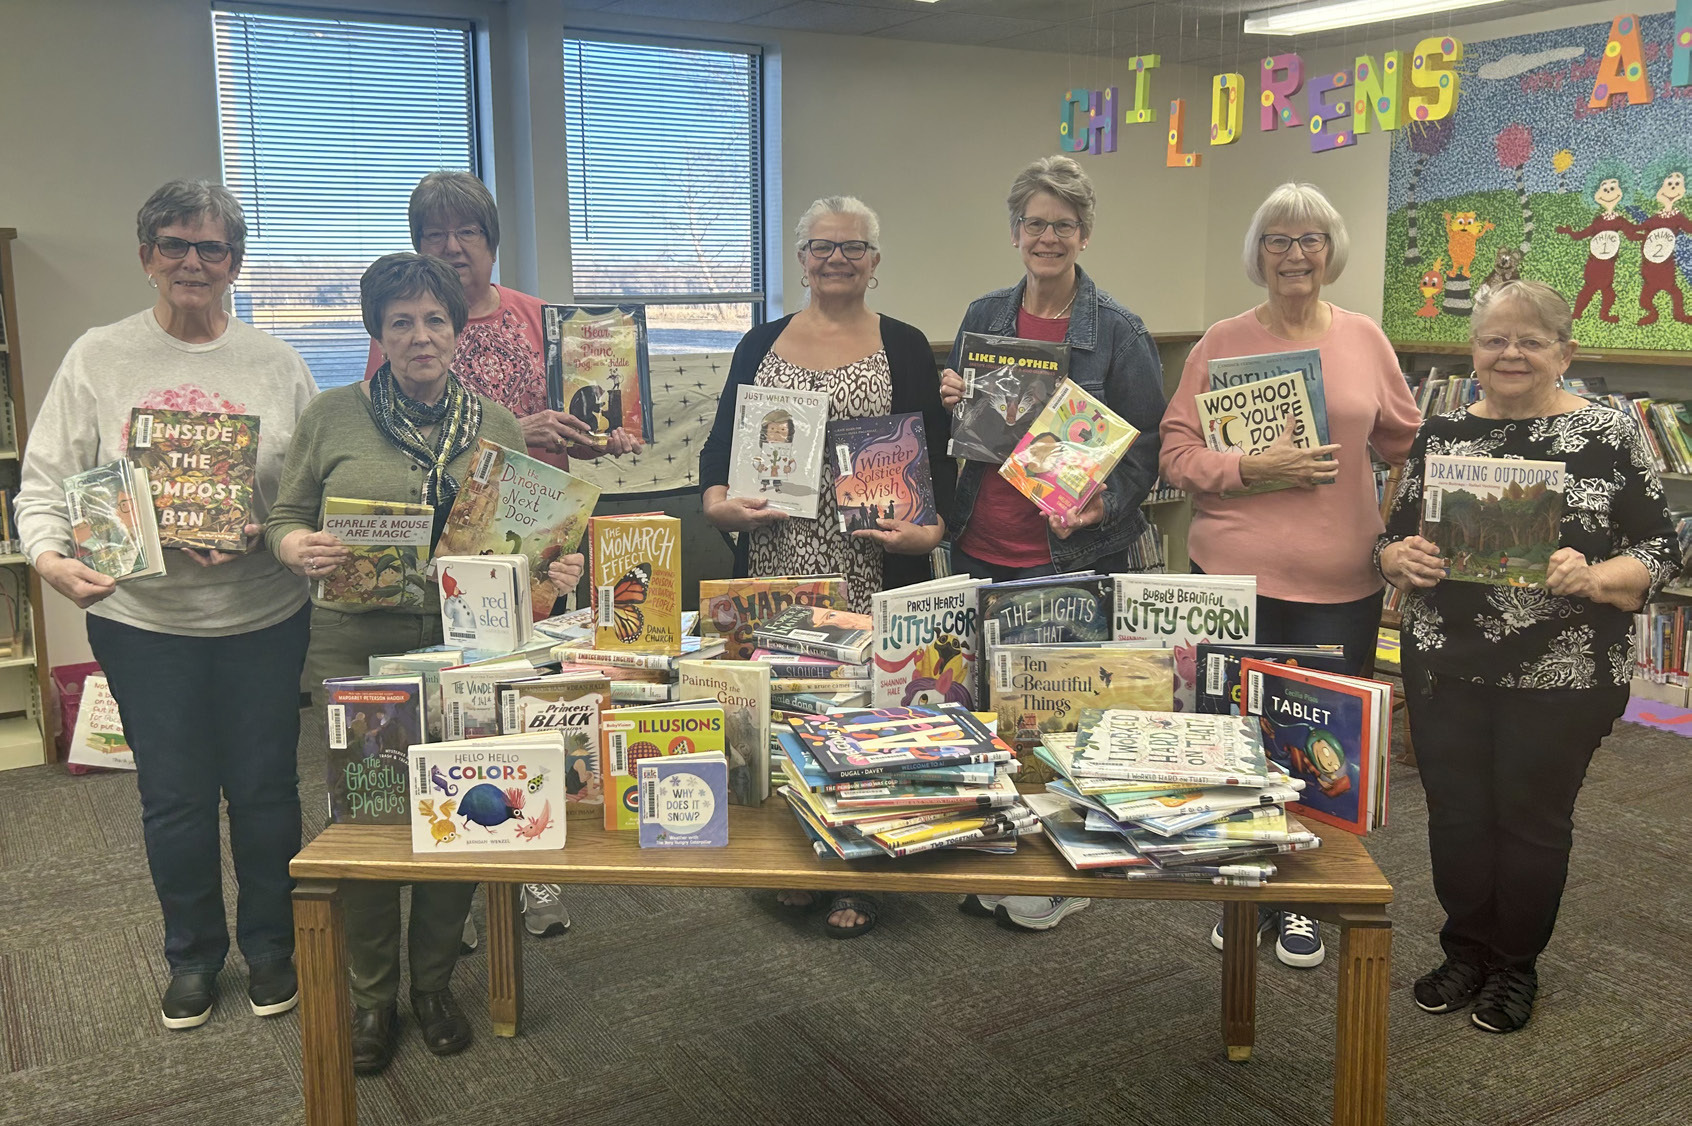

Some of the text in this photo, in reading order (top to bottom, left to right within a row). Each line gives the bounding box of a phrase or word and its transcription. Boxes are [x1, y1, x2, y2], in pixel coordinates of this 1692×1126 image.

[1059, 36, 1463, 167] CHILDRENS
[1594, 233, 1617, 244] THING
[1647, 230, 1674, 243] THING
[1600, 243, 1610, 254] 1
[1652, 244, 1664, 258] 2
[968, 352, 1058, 370] LIKE NO OTHER
[744, 391, 819, 406] JUST WHAT TO DO
[1204, 379, 1297, 416] WOO HOO!
[1240, 400, 1303, 427] YOU'RE
[152, 423, 233, 442] INSIDE
[1250, 419, 1305, 446] DOIG
[168, 453, 211, 470] THE
[861, 445, 913, 471] Winter
[500, 463, 566, 502] Dinosaur
[527, 468, 539, 480] the
[855, 466, 901, 488] Solstice
[1431, 462, 1559, 486] DRAWING OUTDOORS
[149, 481, 242, 500] OMPOST
[864, 478, 906, 501] Wish
[502, 489, 540, 513] Next
[160, 509, 204, 526] BIN
[326, 520, 429, 529] CHARLIE & MOUSE
[504, 505, 538, 528] Door
[345, 529, 412, 538] ARE MAGIC
[604, 527, 621, 539] THE
[600, 527, 675, 569] MONARCH
[602, 551, 645, 586] EFFECT
[482, 592, 508, 609] red
[907, 593, 965, 613] PARTY HEARTY
[1143, 588, 1224, 607] BUBBLY BEAUTIFUL
[480, 610, 509, 628] sled
[1000, 597, 1095, 628] THE LIGHTS
[1116, 597, 1249, 640] KITTY-CORN
[647, 624, 666, 634] DANA
[882, 608, 976, 650] KITTY-COR
[1034, 626, 1064, 643] THAT
[645, 634, 674, 643] CHURCH
[766, 639, 828, 656] FORCE NATURE
[786, 666, 824, 677] SLOUCH
[1021, 656, 1047, 672] Ten
[452, 681, 464, 694] THE
[682, 674, 728, 691] Painting
[881, 677, 907, 687] SHANNON
[1012, 674, 1092, 692] Beautiful
[545, 703, 590, 713] Princess
[717, 691, 756, 708] Game
[792, 697, 813, 710] done
[1021, 694, 1071, 718] Things
[1272, 695, 1332, 725] TABLET
[528, 712, 594, 728] BLACK
[639, 718, 721, 733] ILLUSIONS
[843, 714, 979, 749] AI
[1110, 714, 1139, 754] WORKED
[826, 730, 864, 762] WELCOME
[1149, 732, 1178, 764] HARD
[1184, 718, 1216, 766] ON THAT!
[363, 753, 380, 768] The
[455, 753, 520, 764] HELLO HELLO
[344, 762, 405, 793] Ghostly
[448, 764, 528, 780] COLORS
[673, 789, 694, 798] WHY
[347, 790, 404, 818] Photos
[666, 800, 700, 810] DOES IT
[668, 812, 700, 821] SNOW?
[946, 833, 978, 845] TOGETHER
